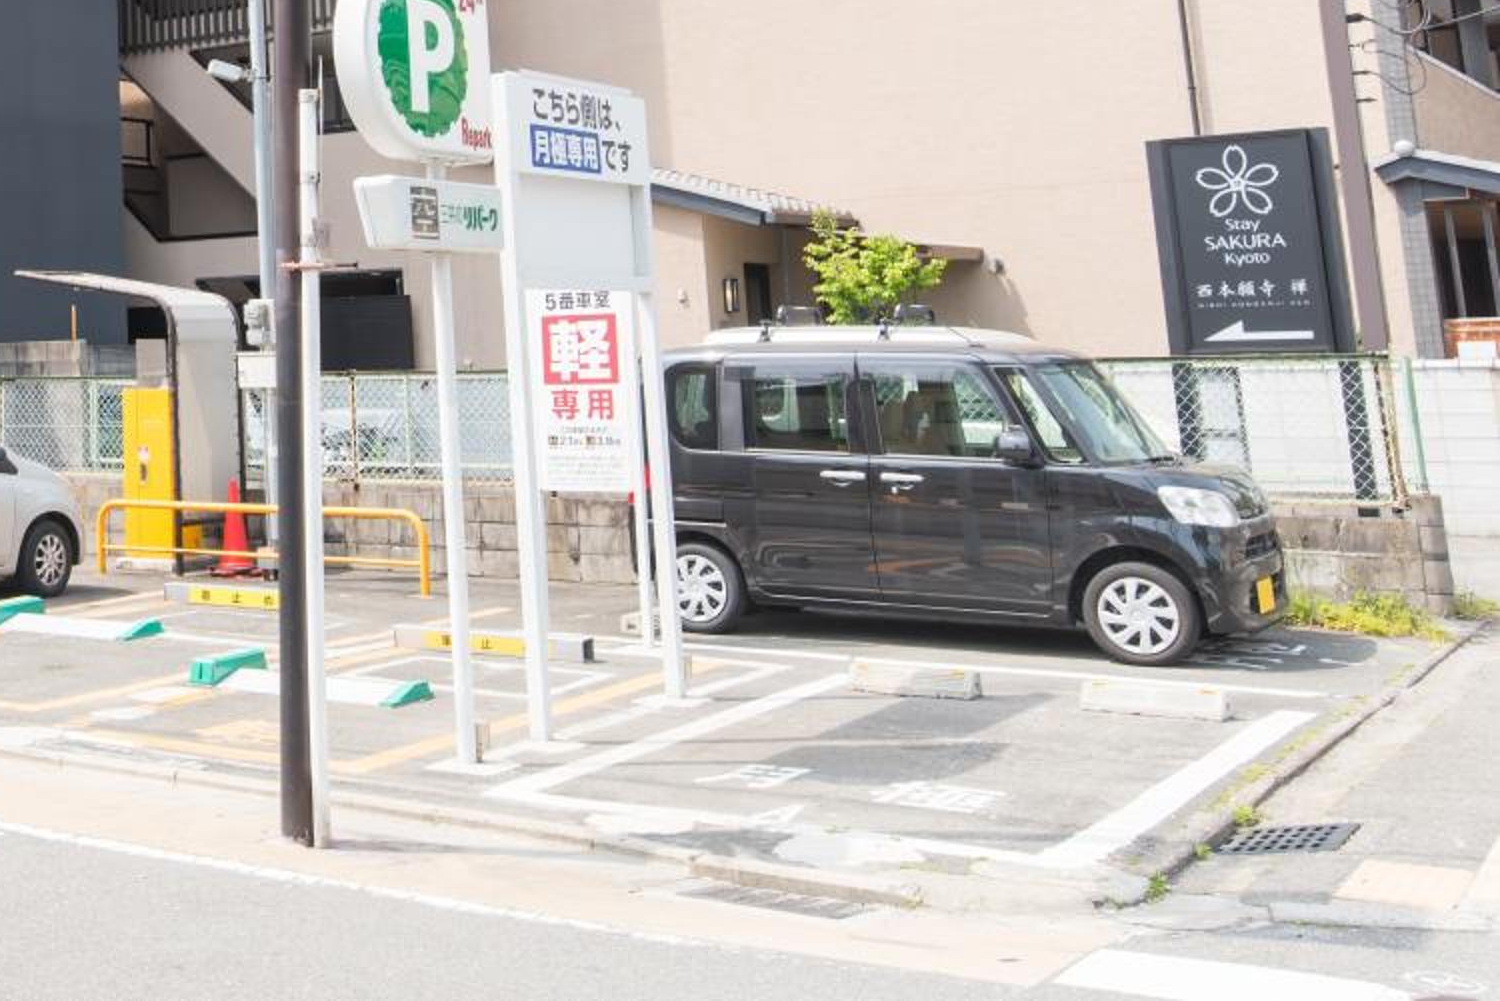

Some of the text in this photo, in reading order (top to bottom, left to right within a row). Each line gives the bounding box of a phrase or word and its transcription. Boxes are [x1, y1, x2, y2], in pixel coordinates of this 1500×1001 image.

[1224, 218, 1260, 232] Stay
[1204, 232, 1287, 252] SAKURA
[1224, 252, 1271, 268] Kyoto
[1197, 279, 1276, 298] 西本願寺
[548, 319, 613, 381] 軽
[551, 389, 615, 420] 専用
